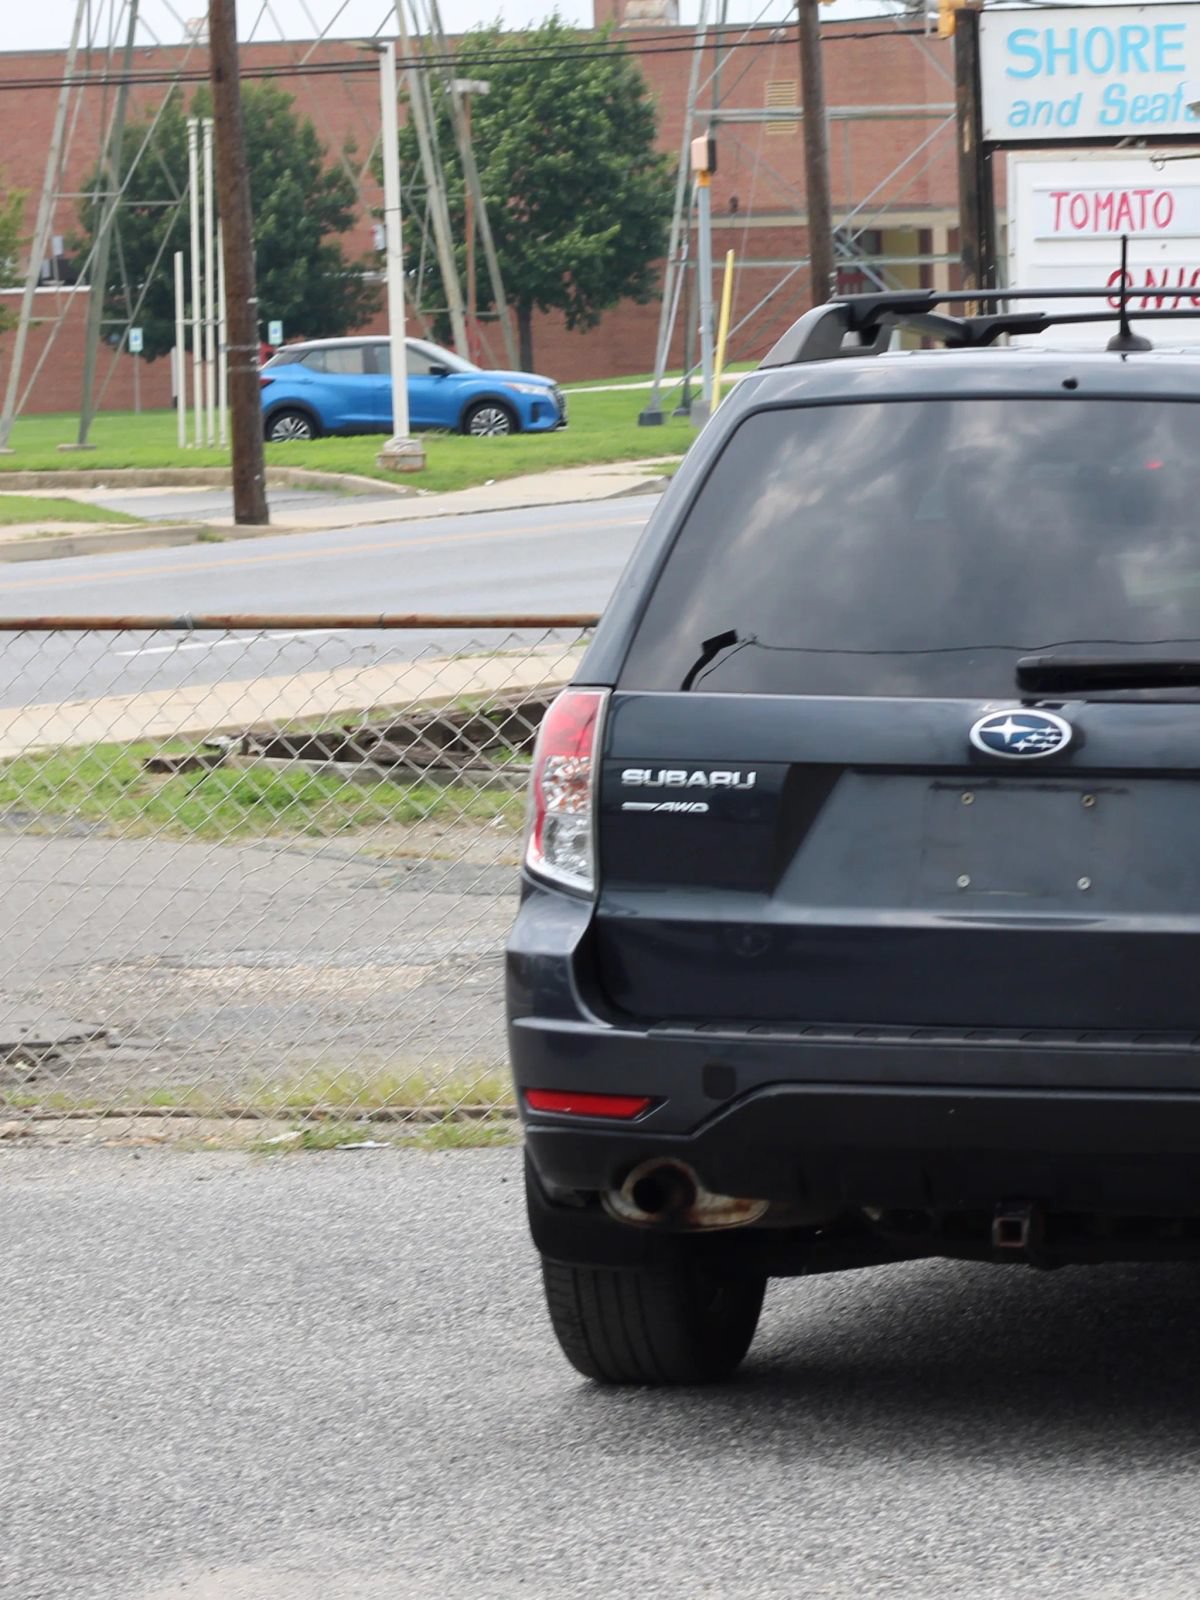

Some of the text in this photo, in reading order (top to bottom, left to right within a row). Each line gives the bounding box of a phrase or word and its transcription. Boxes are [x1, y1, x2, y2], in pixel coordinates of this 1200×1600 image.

[1006, 22, 1187, 79] SHORE
[1007, 92, 1083, 127] and
[1049, 189, 1175, 233] TOMATO
[621, 768, 757, 789] SUBARU
[654, 801, 709, 813] AWD
